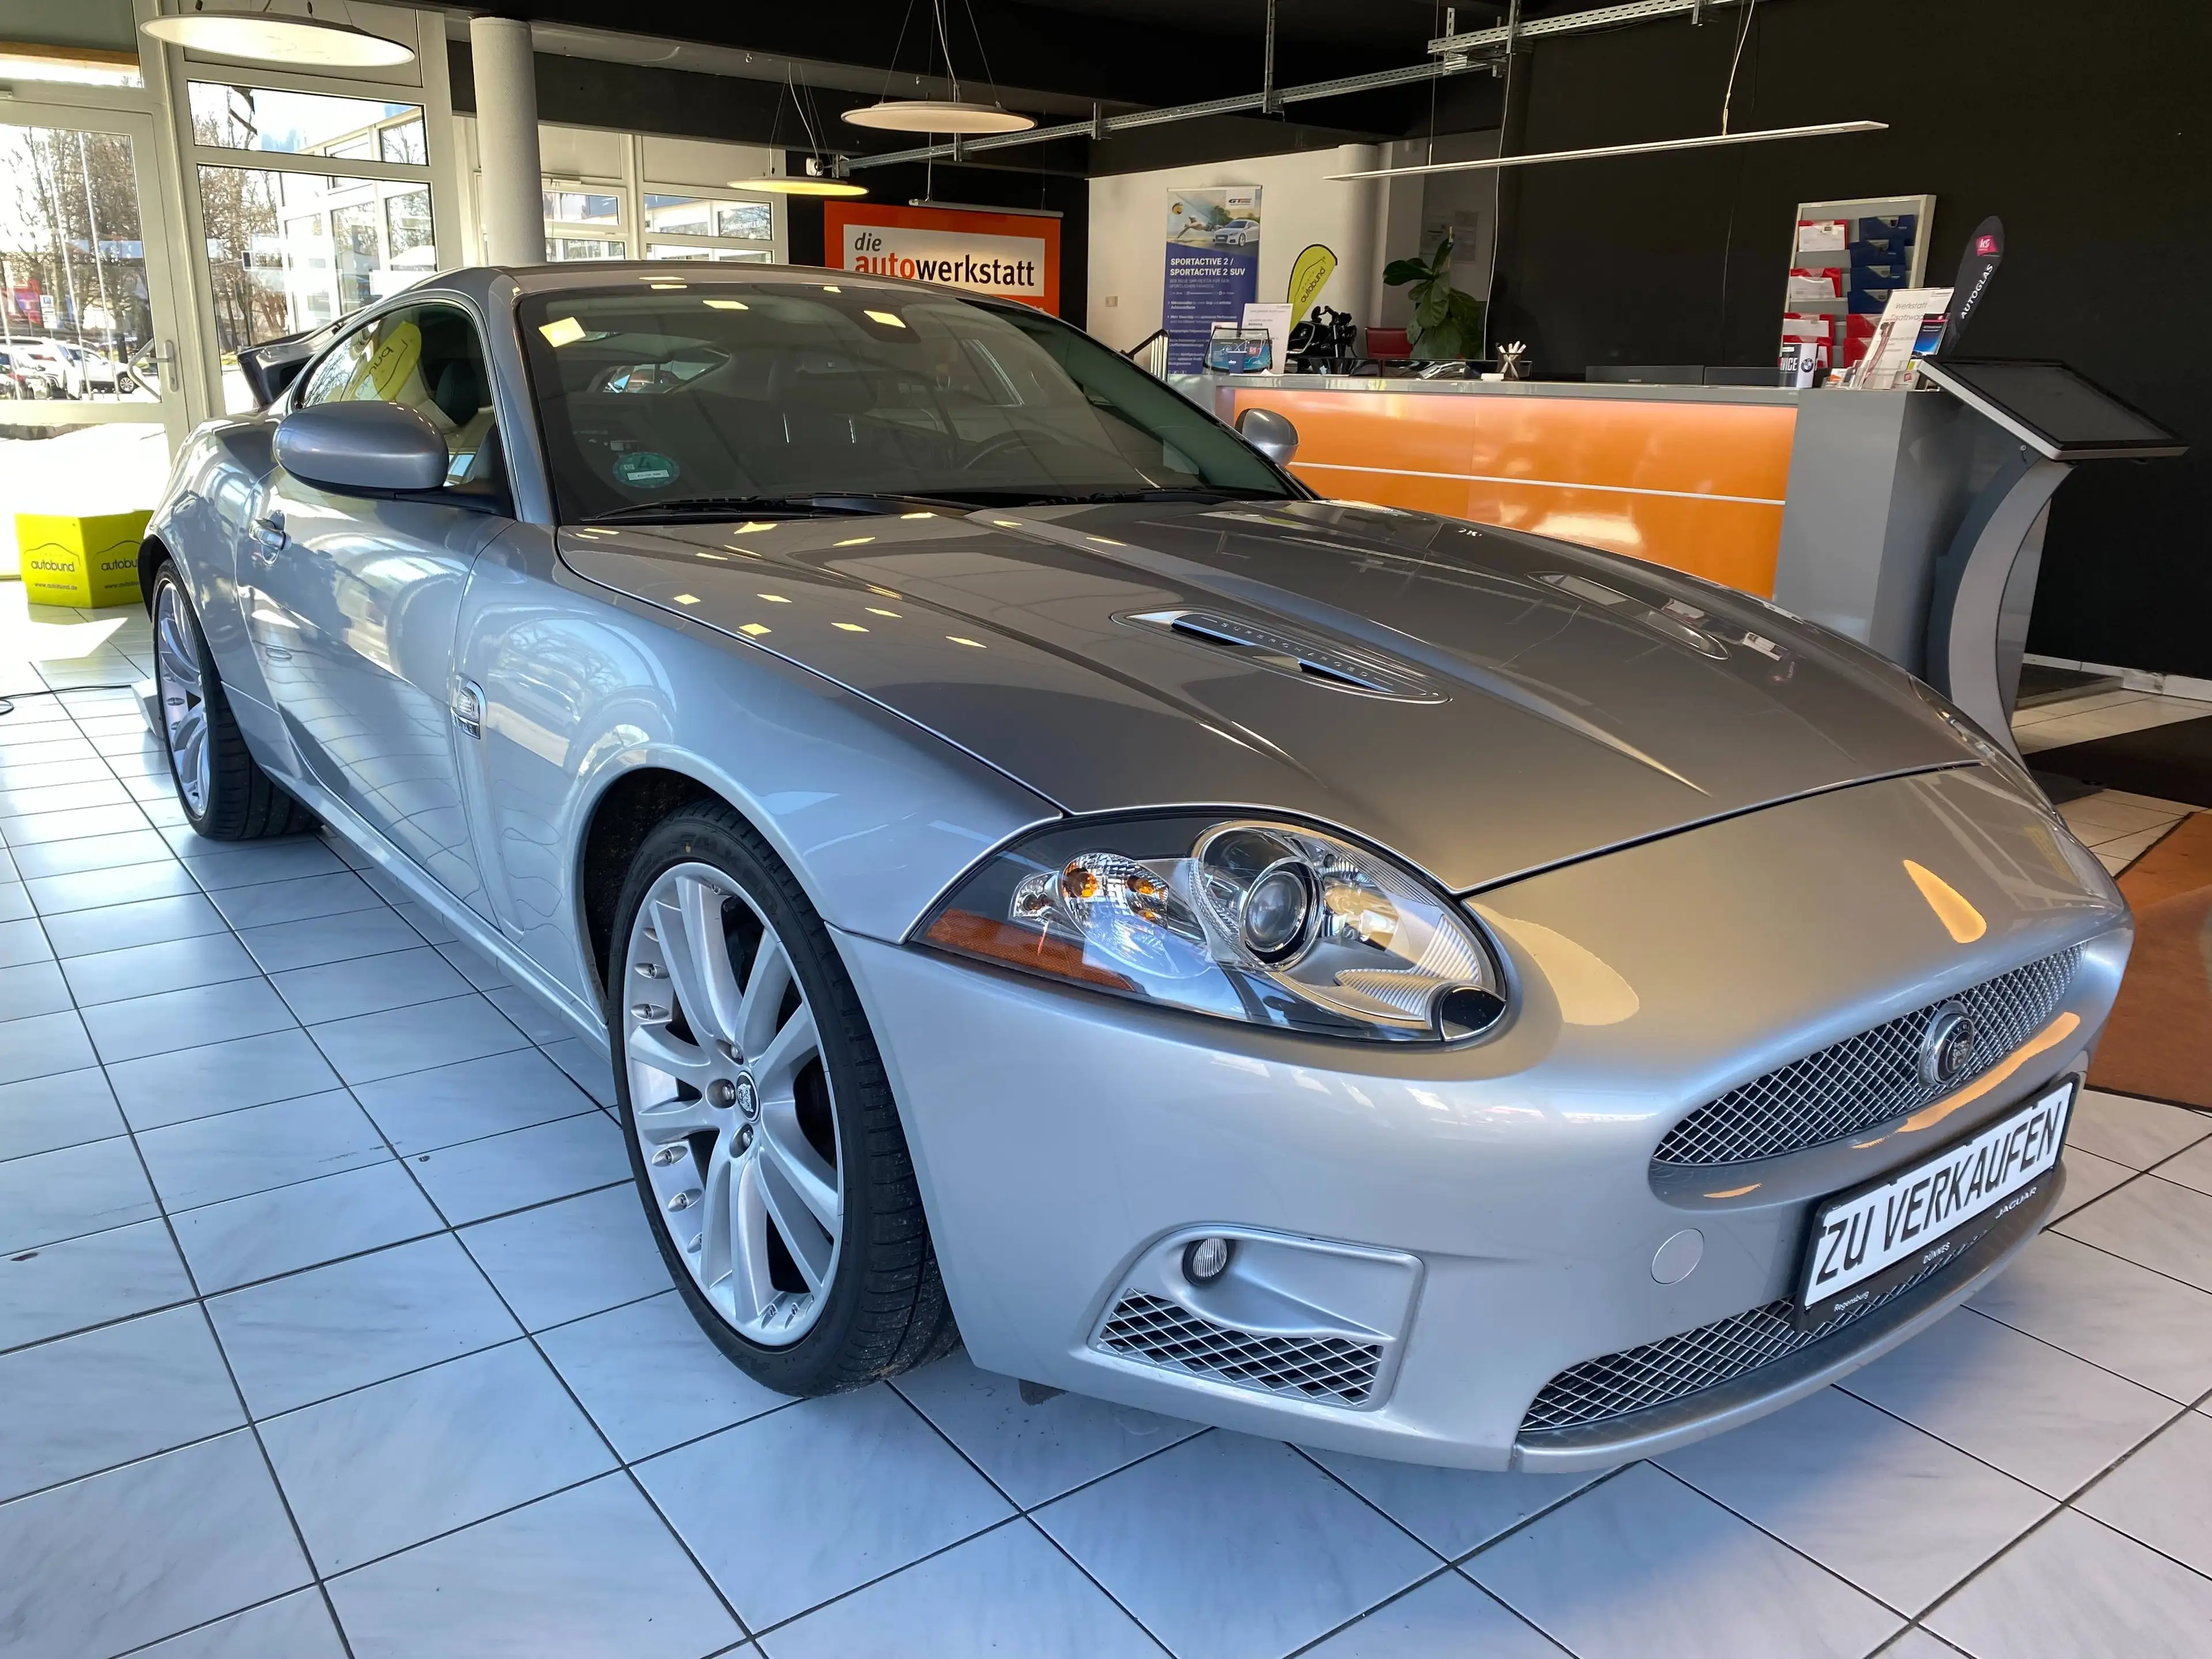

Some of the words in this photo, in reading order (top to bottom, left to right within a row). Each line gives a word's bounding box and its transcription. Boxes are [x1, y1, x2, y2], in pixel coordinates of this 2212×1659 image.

[855, 232, 882, 251] die
[855, 252, 1035, 286] autowerkstatt
[1301, 266, 1325, 303] autobund
[1961, 264, 1993, 319] AUTOGLAS
[31, 559, 75, 573] autobund
[35, 582, 78, 591] www.autobund.de
[1221, 622, 1369, 677] SUPERCHARGED
[1816, 1205, 1875, 1286] ZU
[1884, 1101, 2062, 1252] VERKAUFEN
[1995, 1186, 2037, 1219] JAGUAR
[1834, 1291, 1870, 1312] Regensburg
